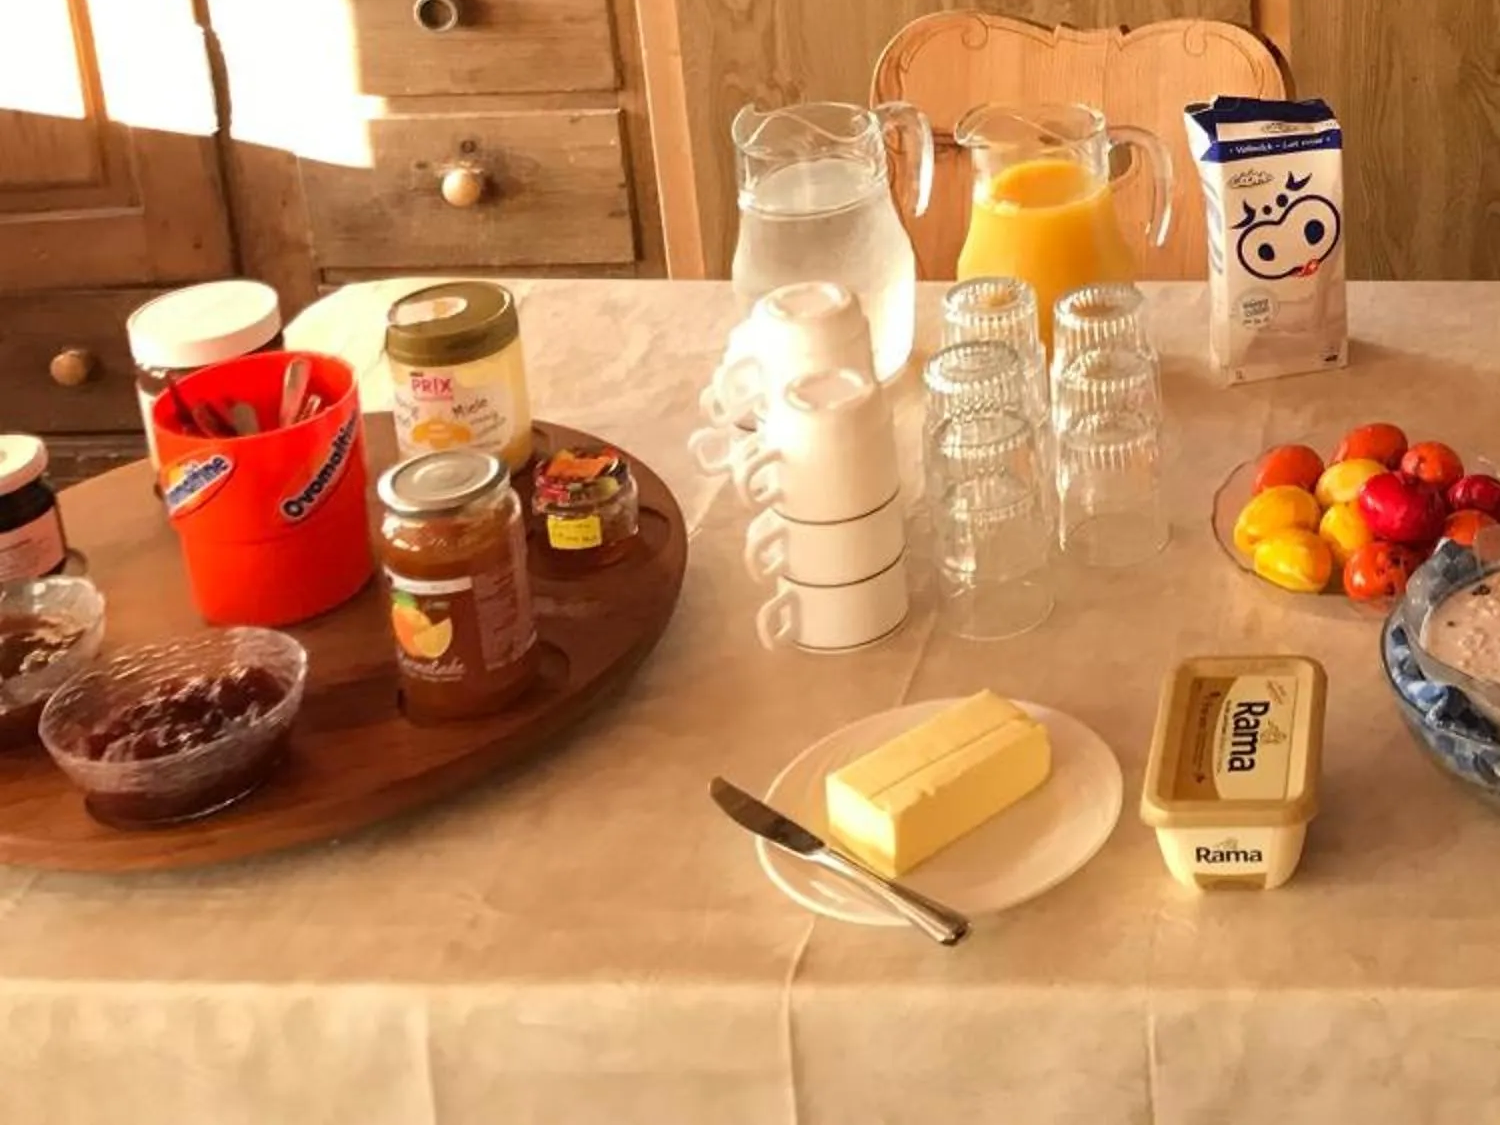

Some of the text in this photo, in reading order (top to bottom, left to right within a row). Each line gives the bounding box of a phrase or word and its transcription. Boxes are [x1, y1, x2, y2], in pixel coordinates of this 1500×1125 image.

[411, 377, 453, 394] PRIX
[1227, 701, 1271, 773] Rama
[1195, 846, 1263, 864] Rama
